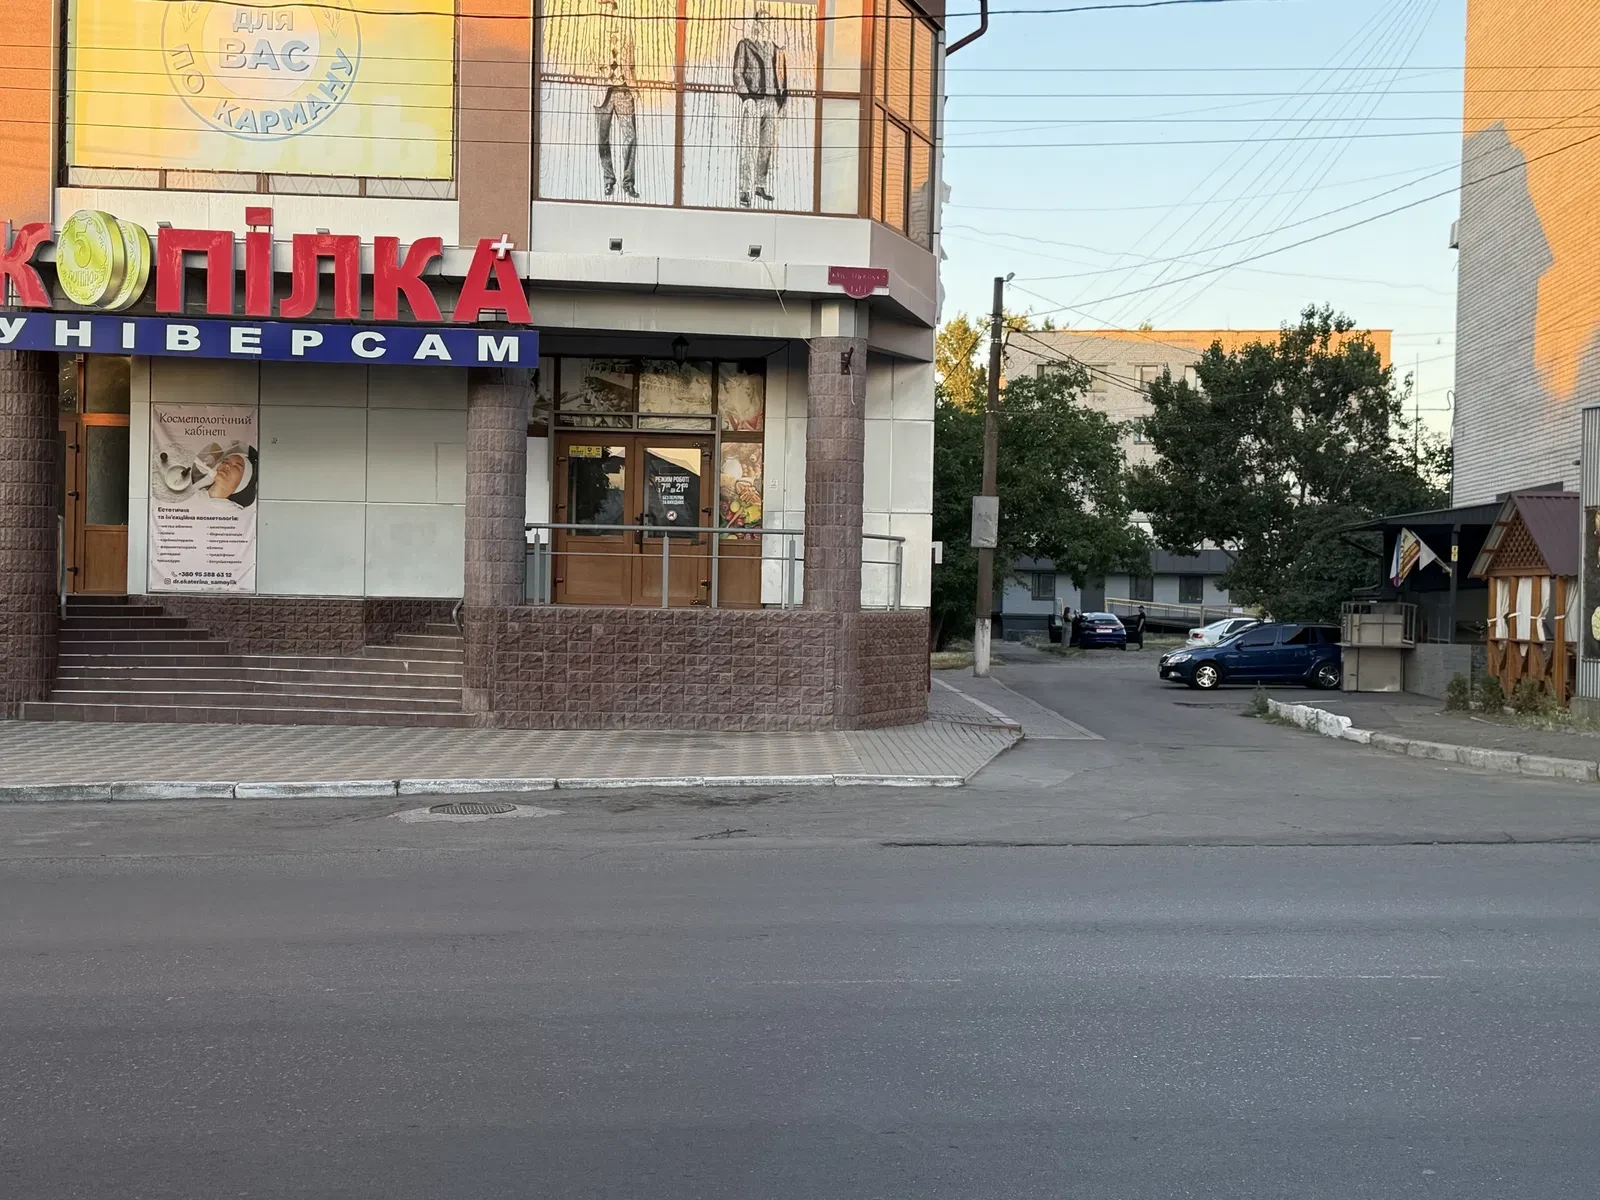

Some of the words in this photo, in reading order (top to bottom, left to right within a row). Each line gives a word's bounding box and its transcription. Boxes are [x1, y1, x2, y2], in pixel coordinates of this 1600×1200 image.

[232, 8, 294, 33] ДЛЯ
[218, 37, 311, 72] ВАС
[170, 43, 206, 95] ПО
[212, 47, 354, 135] КАРМАНУ
[0, 317, 519, 362] УНІВЕРСАМ
[160, 413, 252, 425] Косметологічний
[184, 425, 226, 437] кабінет
